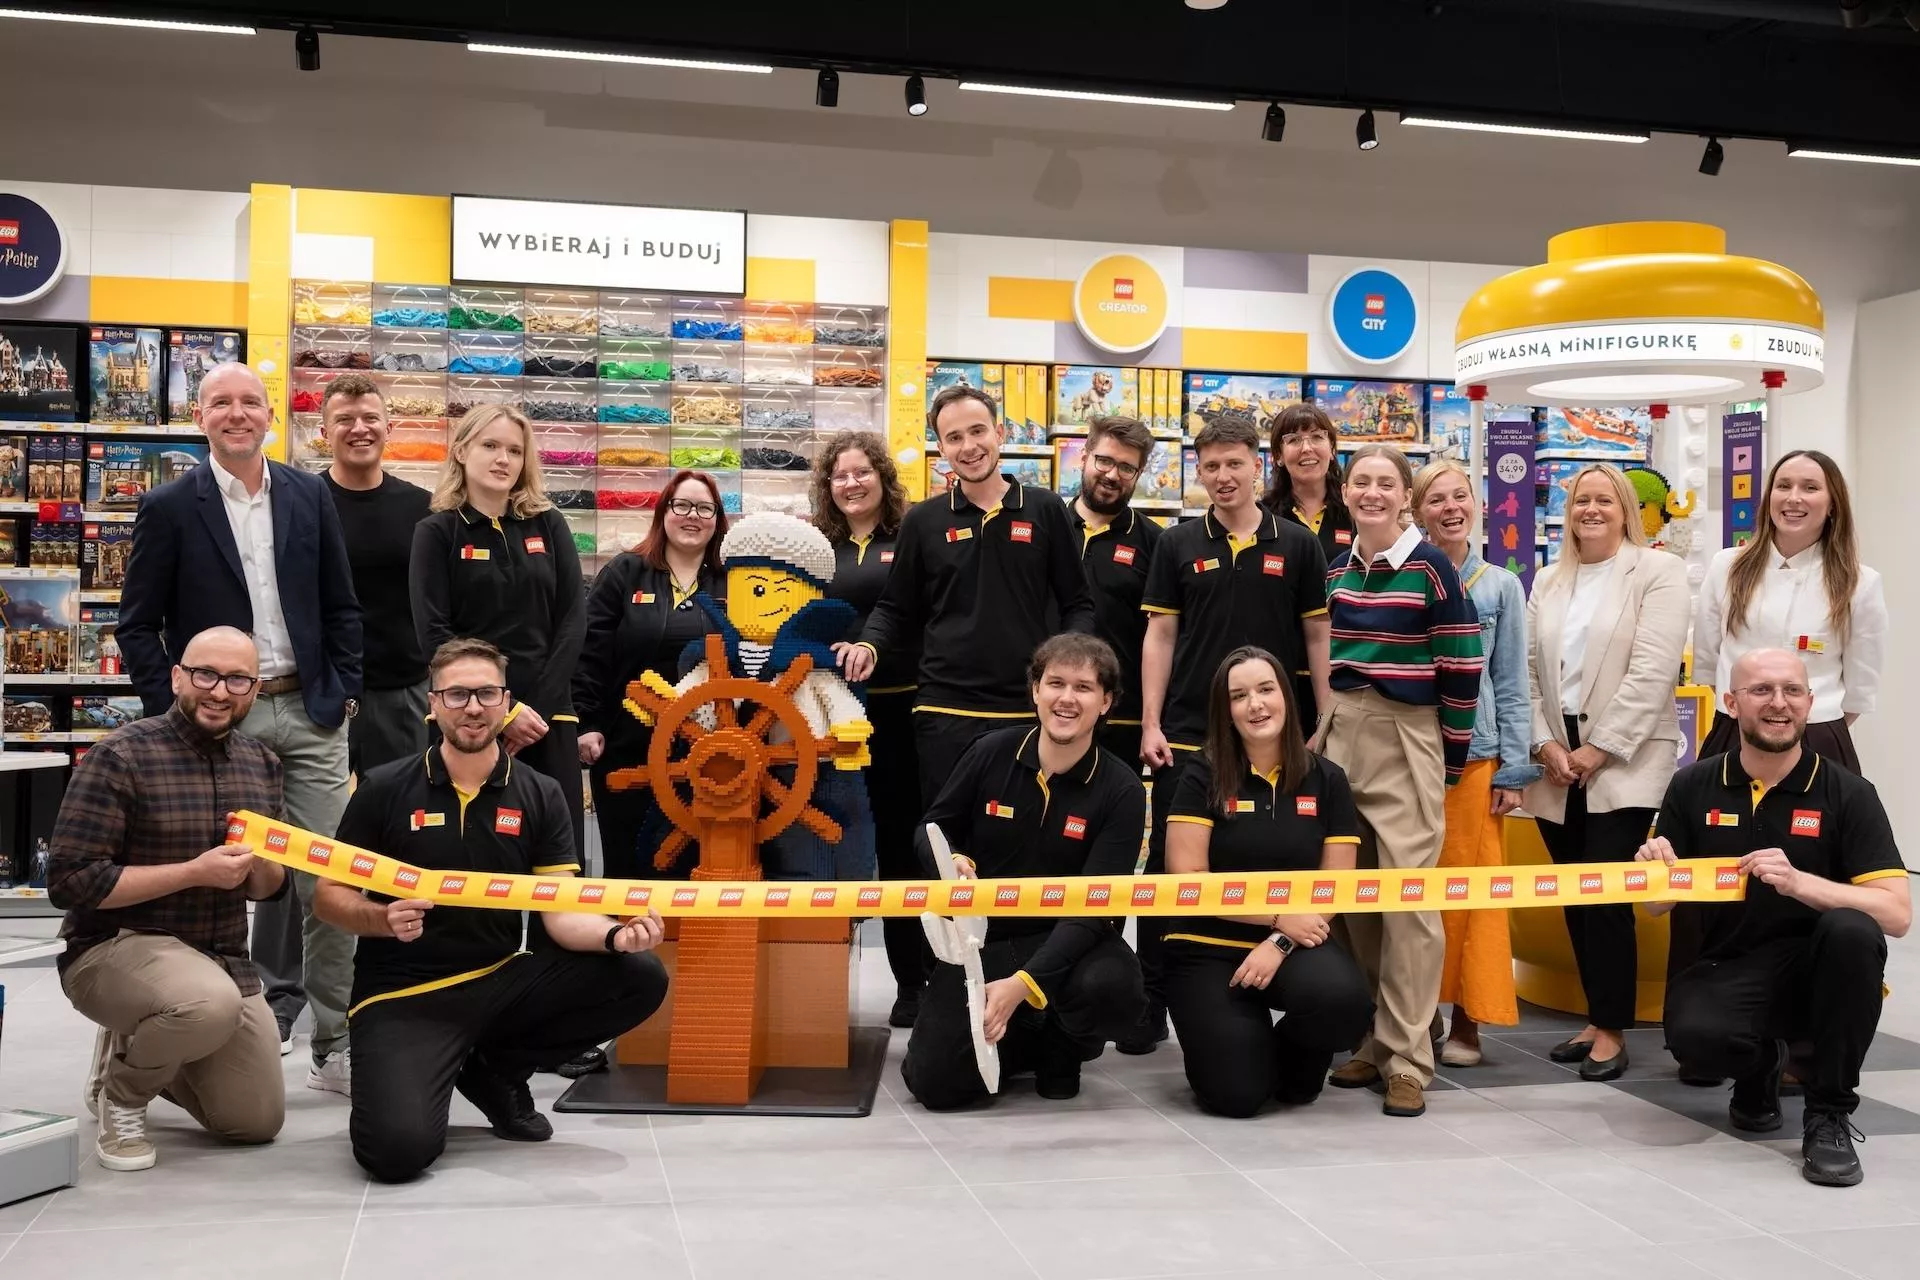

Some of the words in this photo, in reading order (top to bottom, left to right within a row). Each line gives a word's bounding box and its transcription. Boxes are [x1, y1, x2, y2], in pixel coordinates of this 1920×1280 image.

[0, 226, 19, 238] EGO
[5, 247, 39, 269] Potter
[1115, 284, 1133, 294] LEGO
[1098, 302, 1148, 313] CREATOR
[1366, 299, 1384, 310] LEGO
[1361, 317, 1387, 331] CITY
[1767, 338, 1812, 357] ZBUDUJ
[1457, 352, 1483, 372] ZBUDUJ
[1488, 342, 1551, 361] WŁASNĄ
[1204, 378, 1219, 387] CITY
[1329, 384, 1344, 392] CITY
[124, 445, 142, 455] Potter
[1499, 465, 1524, 473] 34.99
[1012, 527, 1032, 536] LEGO
[1115, 550, 1133, 560] LEGO
[1264, 560, 1283, 569] LEGO
[497, 815, 521, 827] LEGO
[1793, 817, 1820, 828] LEGO
[1066, 822, 1086, 833] LEGO
[268, 835, 286, 846] LEGO
[310, 847, 330, 858] LEGO
[354, 858, 374, 870] LEGO
[397, 871, 418, 882] LEGO
[443, 880, 464, 889] LEGO
[490, 883, 510, 891] LEGO
[535, 885, 557, 895] LEGO
[581, 887, 604, 897] LEGO
[627, 890, 650, 900] LEGO
[673, 891, 697, 901] LEGO
[720, 891, 744, 901] LEGO
[767, 891, 790, 900] LEGO
[814, 891, 836, 900] LEGO
[860, 890, 881, 900] LEGO
[906, 891, 927, 900] LEGO
[952, 890, 972, 900] LEGO
[998, 890, 1018, 899] LEGO
[1043, 889, 1063, 899] LEGO
[1089, 890, 1109, 899] LEGO
[1134, 890, 1154, 899] LEGO
[1179, 889, 1199, 899] LEGO
[1224, 888, 1244, 898] LEGO
[1269, 888, 1289, 897] LEGO
[1314, 887, 1333, 897] LEGO
[1358, 887, 1378, 897] LEGO
[1403, 885, 1422, 895] LEGO
[1447, 884, 1467, 895] LEGO
[1491, 883, 1512, 893] LEGO
[1535, 881, 1557, 891] LEGO
[1580, 879, 1602, 888] LEGO
[1625, 874, 1647, 885] LEGO
[1670, 872, 1692, 883] LEGO
[1716, 873, 1738, 884] LEGO
